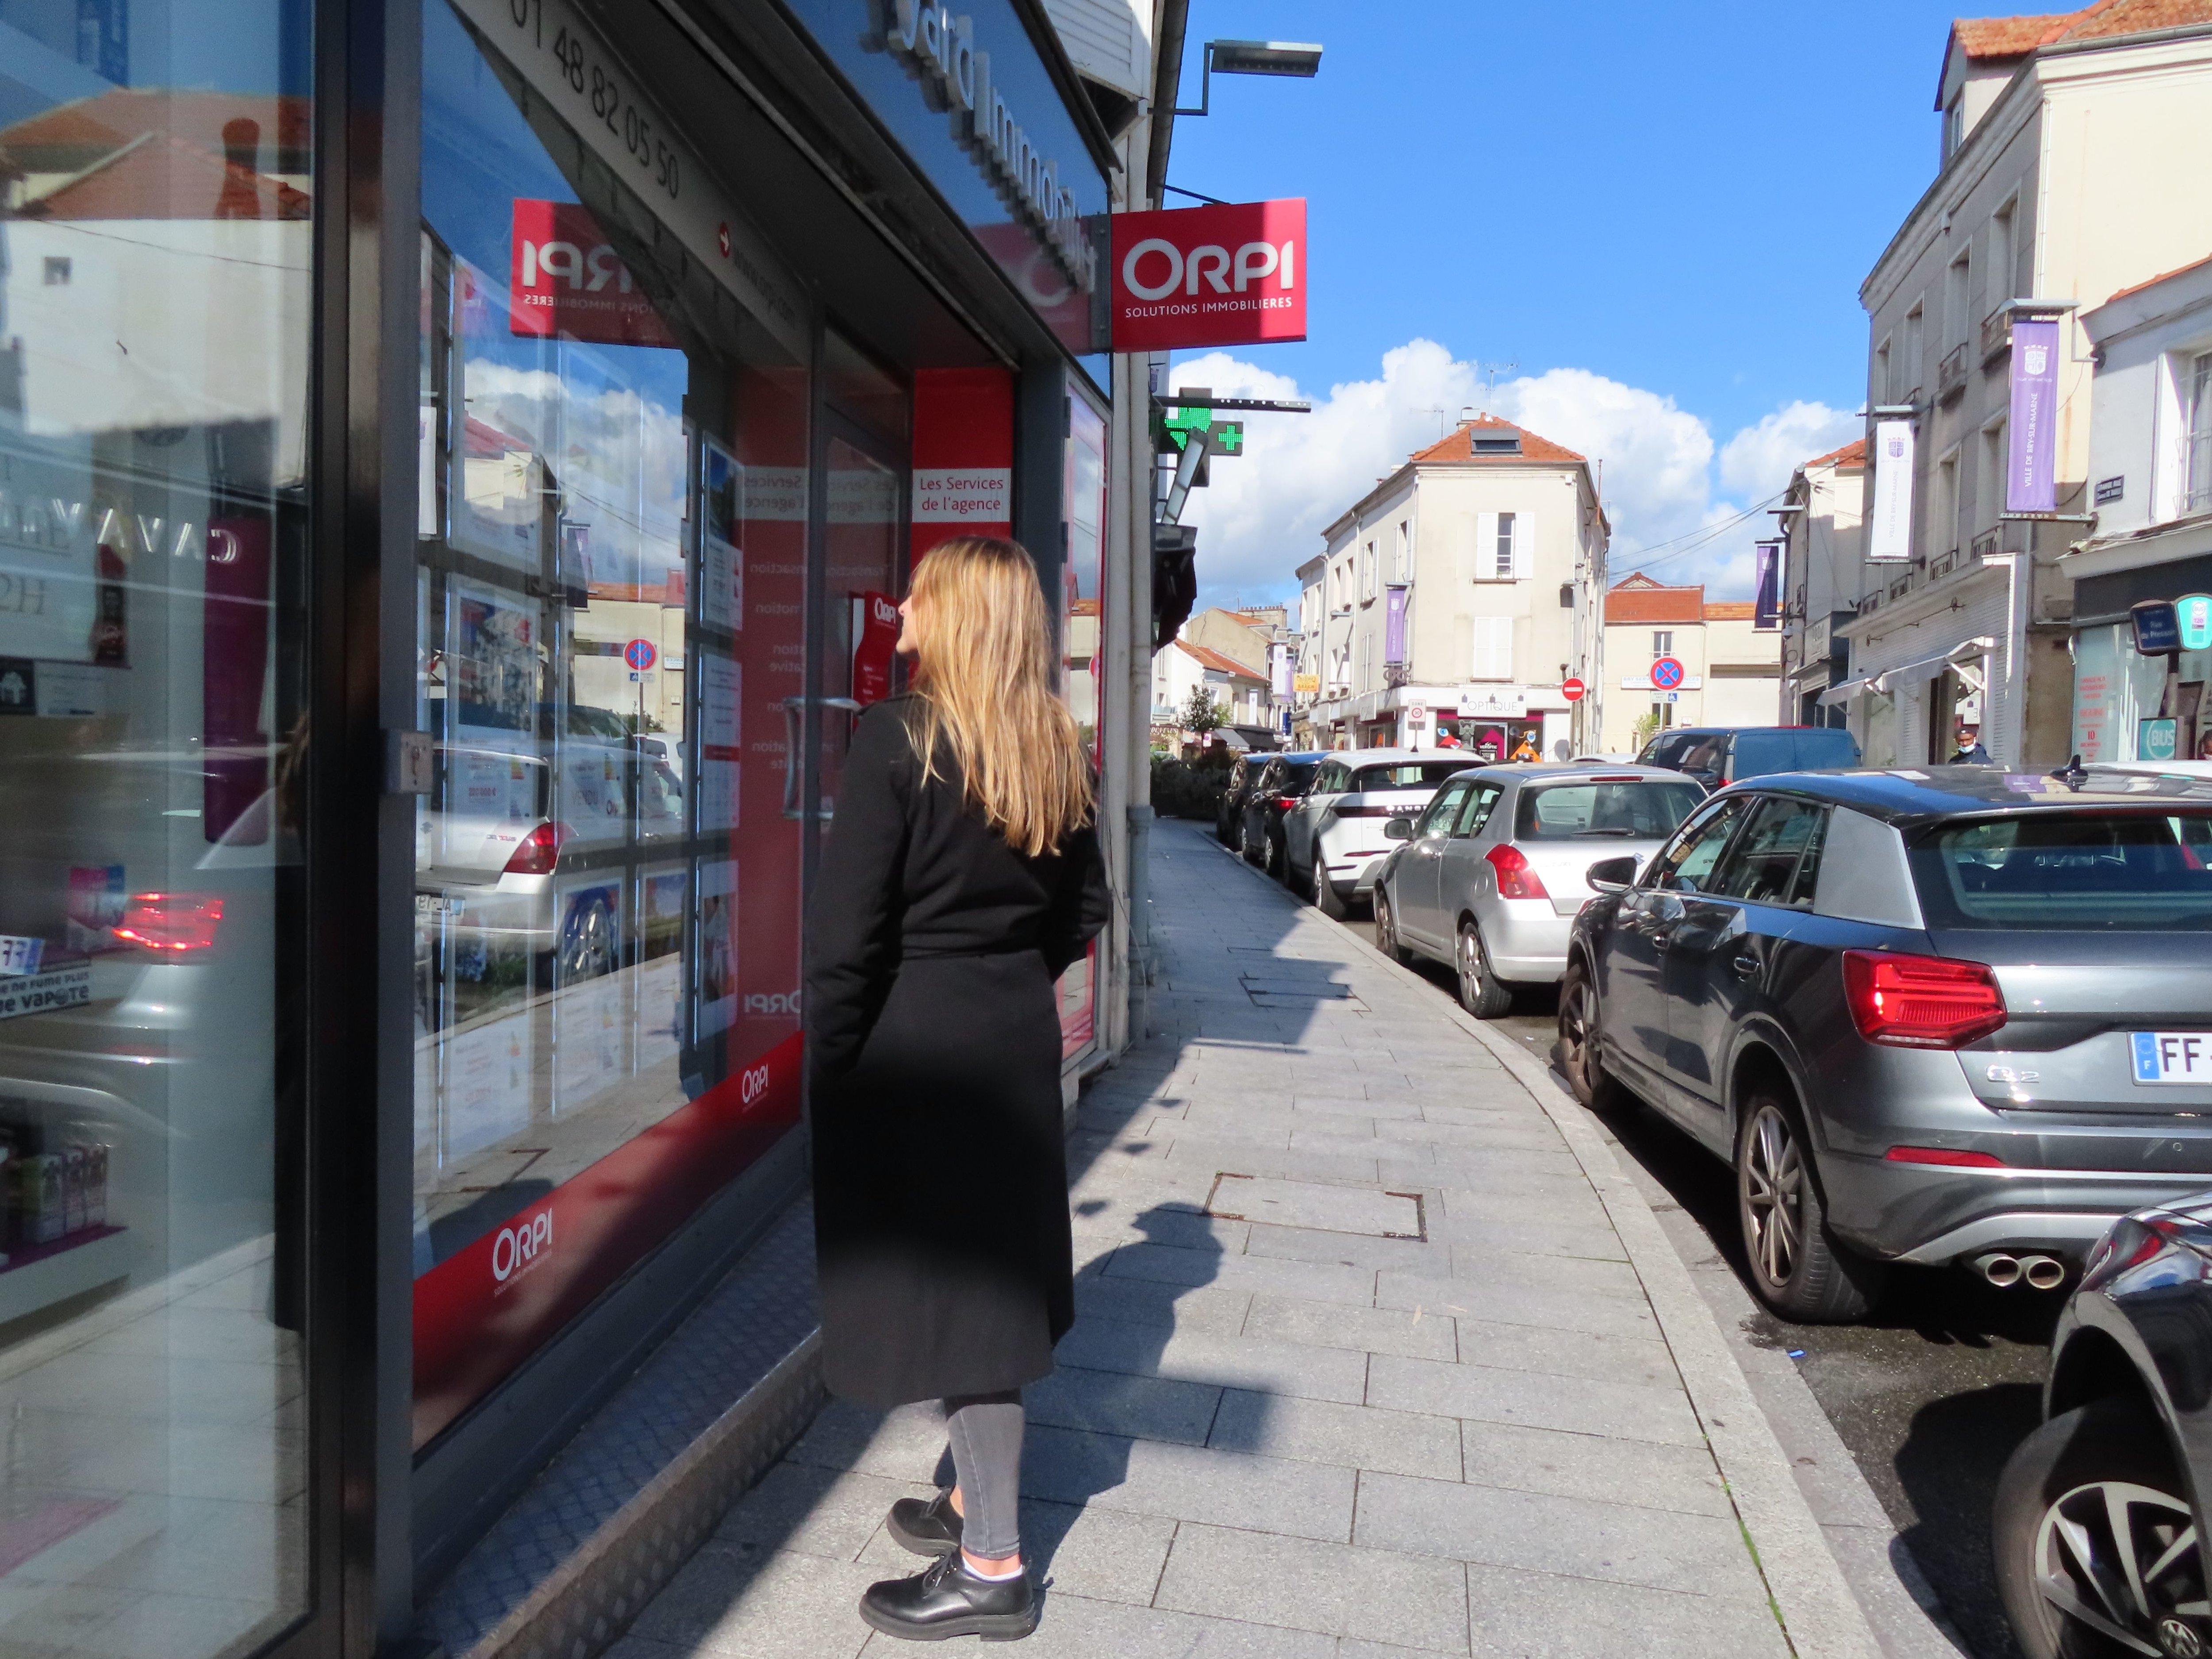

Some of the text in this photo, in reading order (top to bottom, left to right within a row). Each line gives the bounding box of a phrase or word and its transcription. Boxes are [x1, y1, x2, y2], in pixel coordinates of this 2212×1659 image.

[554, 26, 584, 94] 48
[592, 65, 618, 136] 82
[626, 105, 650, 167] 05
[657, 138, 678, 199] 50
[1125, 296, 1293, 318] SOLUTIONS IMMOBILIERES
[2027, 392, 2038, 453] BRY-SUR-MARNE
[2026, 455, 2033, 465] DE
[920, 476, 1004, 491] Les Services
[922, 497, 1001, 515] de l'agence
[1467, 700, 1517, 711] OPTIQUE
[2151, 730, 2174, 746] BUS
[492, 1207, 553, 1281] ORPI
